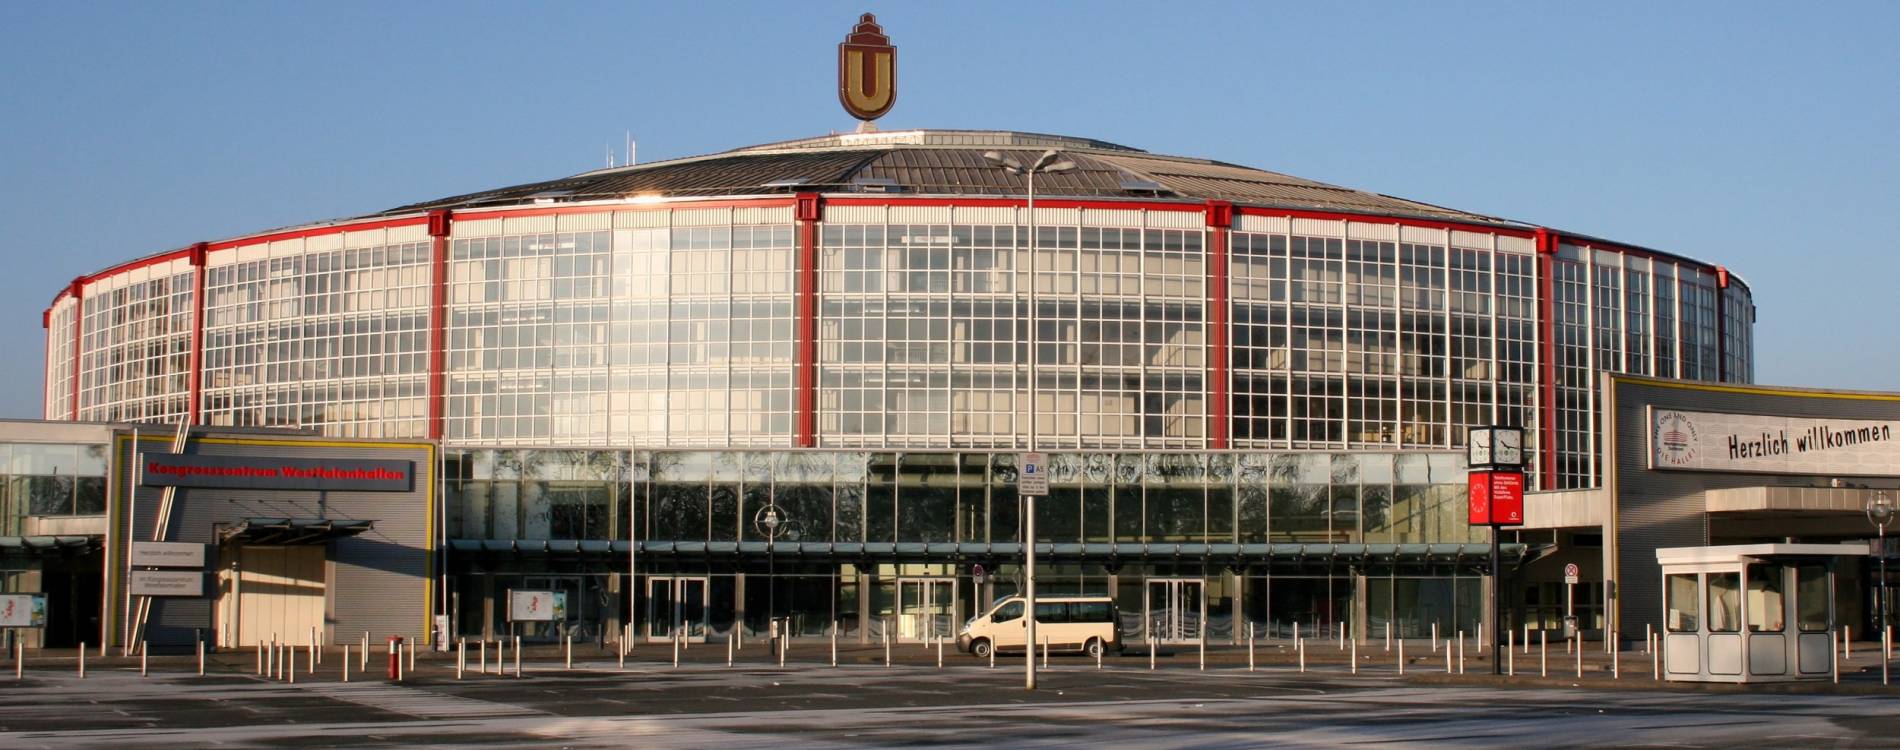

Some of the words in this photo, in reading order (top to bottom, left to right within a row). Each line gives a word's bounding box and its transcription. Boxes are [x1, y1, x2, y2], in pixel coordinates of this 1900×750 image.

[847, 49, 891, 112] U
[1660, 412, 1672, 425] ONE
[1686, 421, 1698, 442] ONLY
[1728, 430, 1789, 460] Herzlich
[1796, 424, 1891, 453] willkommen
[1657, 447, 1669, 461] DIE
[148, 462, 277, 479] Kongresszentrum
[280, 466, 404, 481] Westfalenhallen
